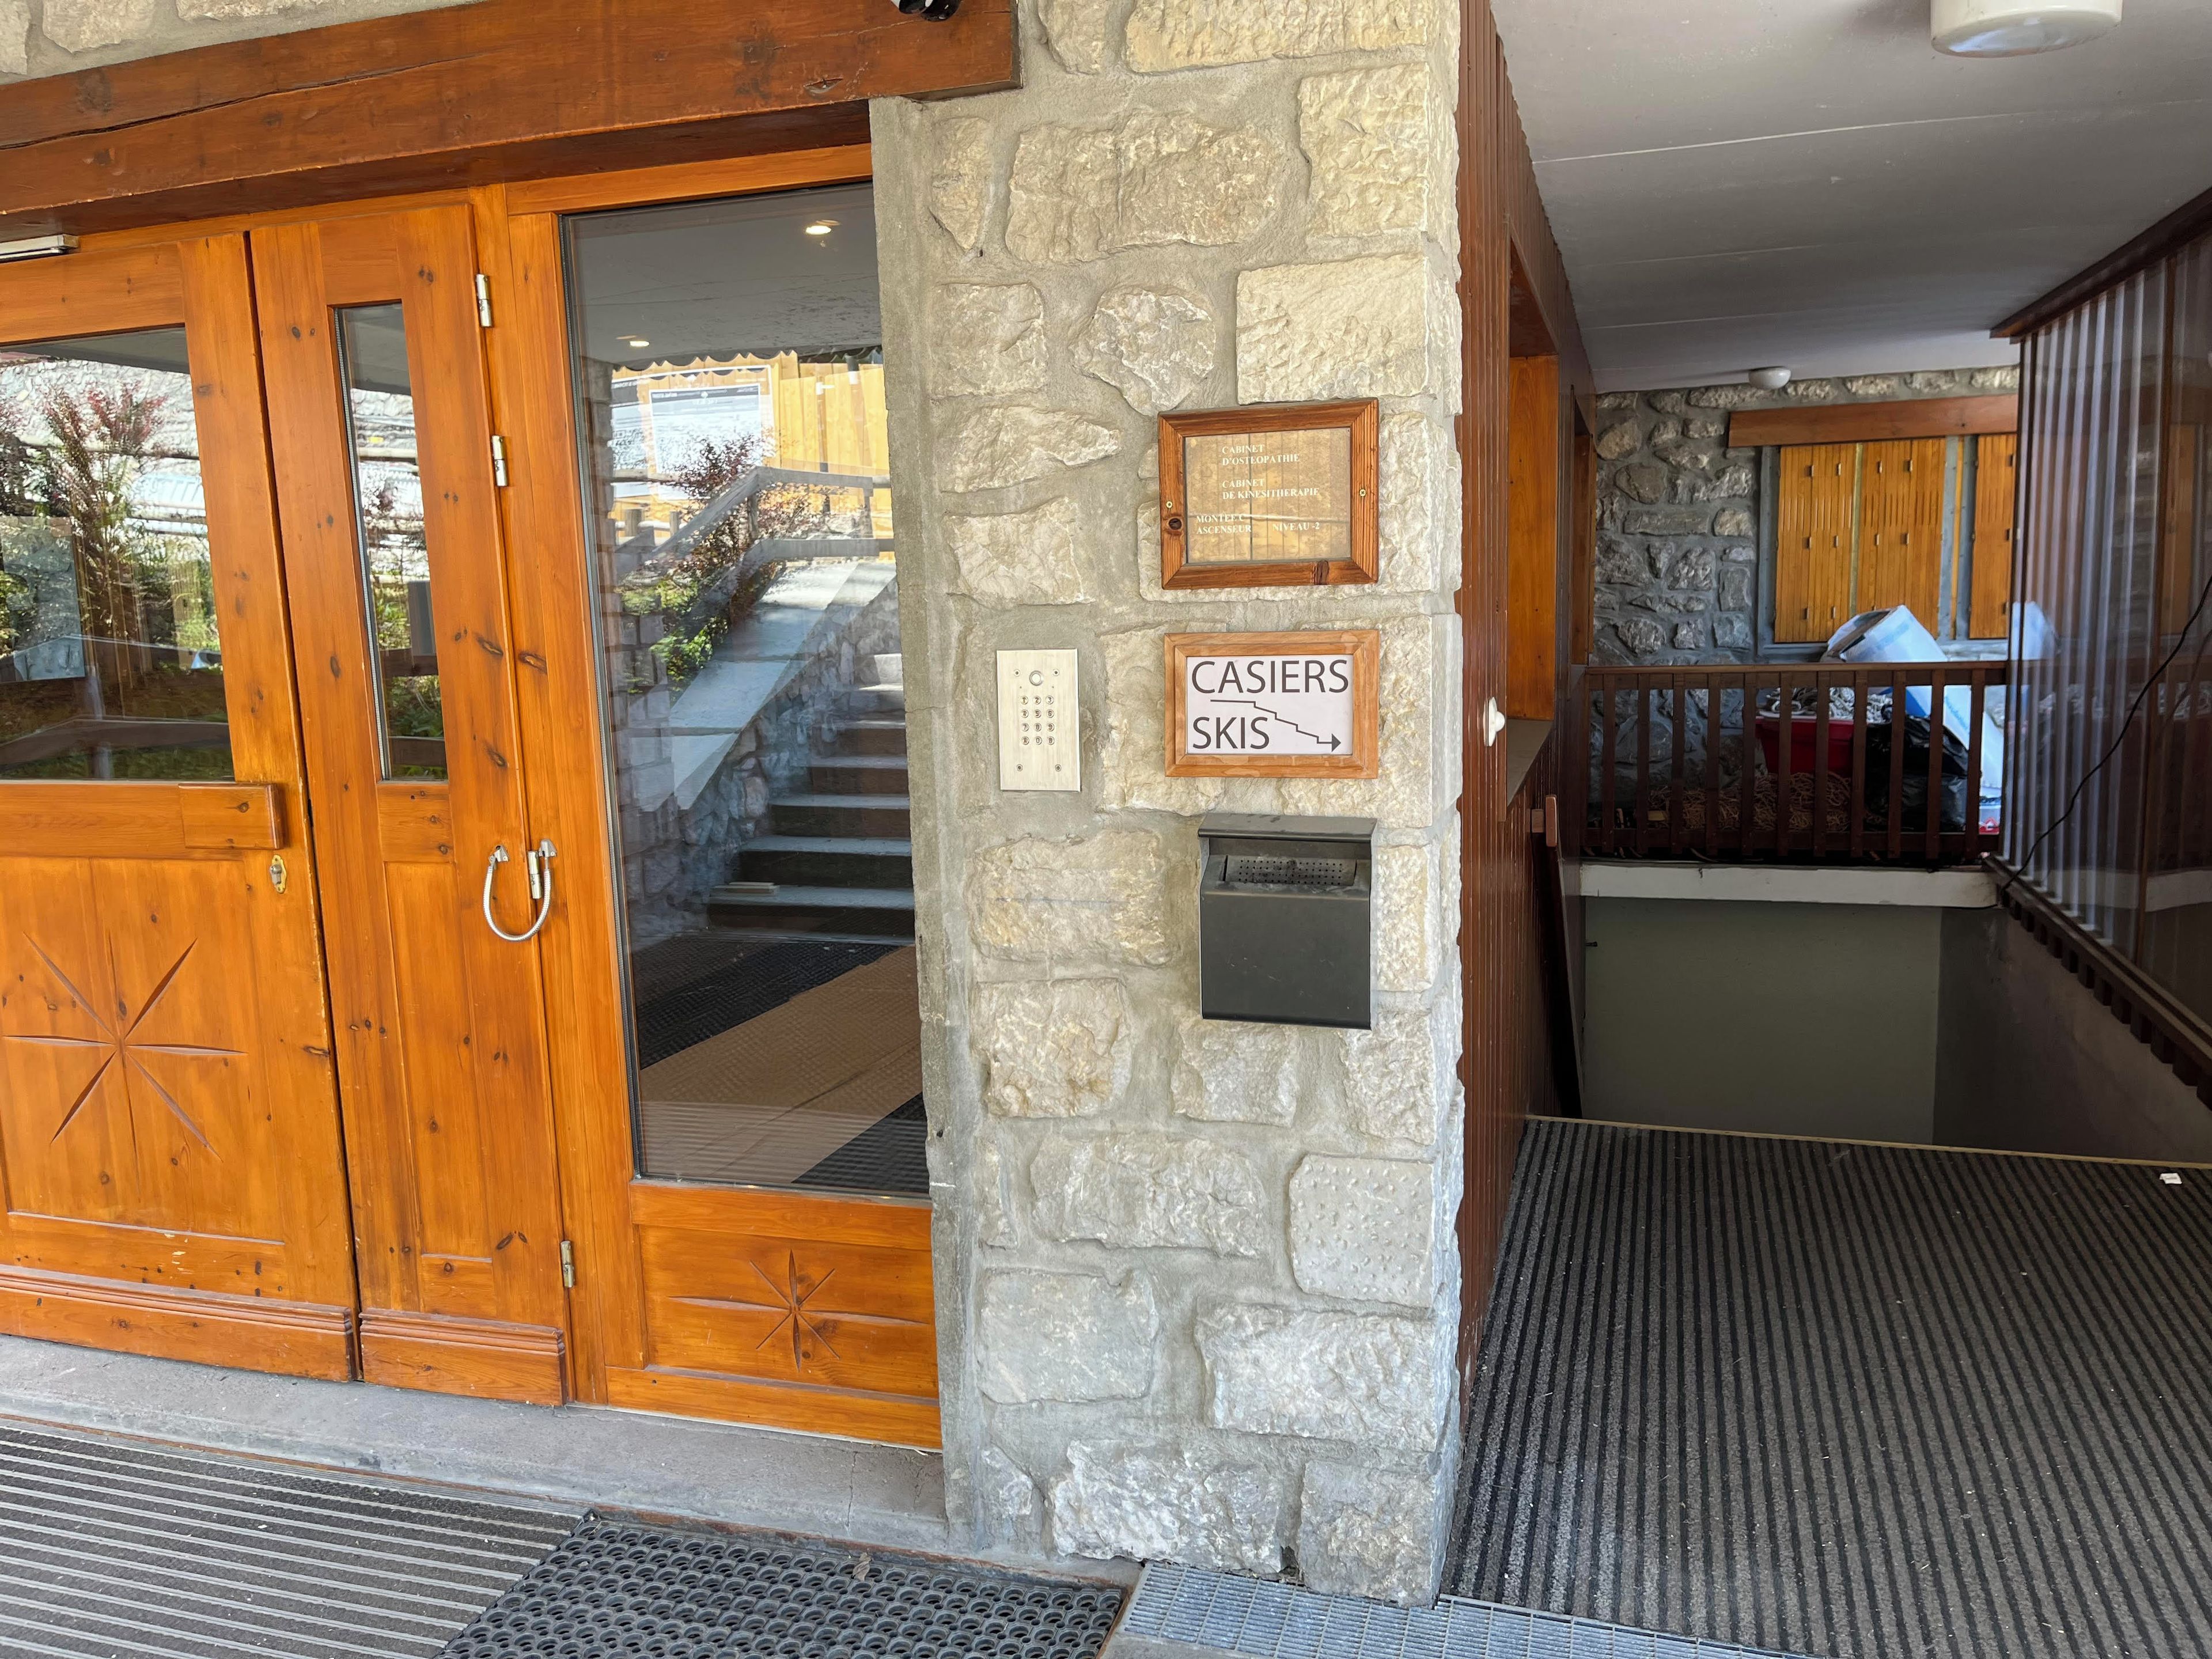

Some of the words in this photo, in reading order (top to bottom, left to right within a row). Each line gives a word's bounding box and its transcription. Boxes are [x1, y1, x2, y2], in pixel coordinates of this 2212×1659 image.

[1222, 444, 1264, 454] CABINET
[1222, 478, 1264, 488] CABINET
[1222, 491, 1236, 500] DE
[1196, 525, 1252, 535] ASCENSEUR
[1272, 522, 1309, 531] NIVEAU
[1192, 659, 1349, 694] CASIERS
[1192, 717, 1270, 749] SKIS
